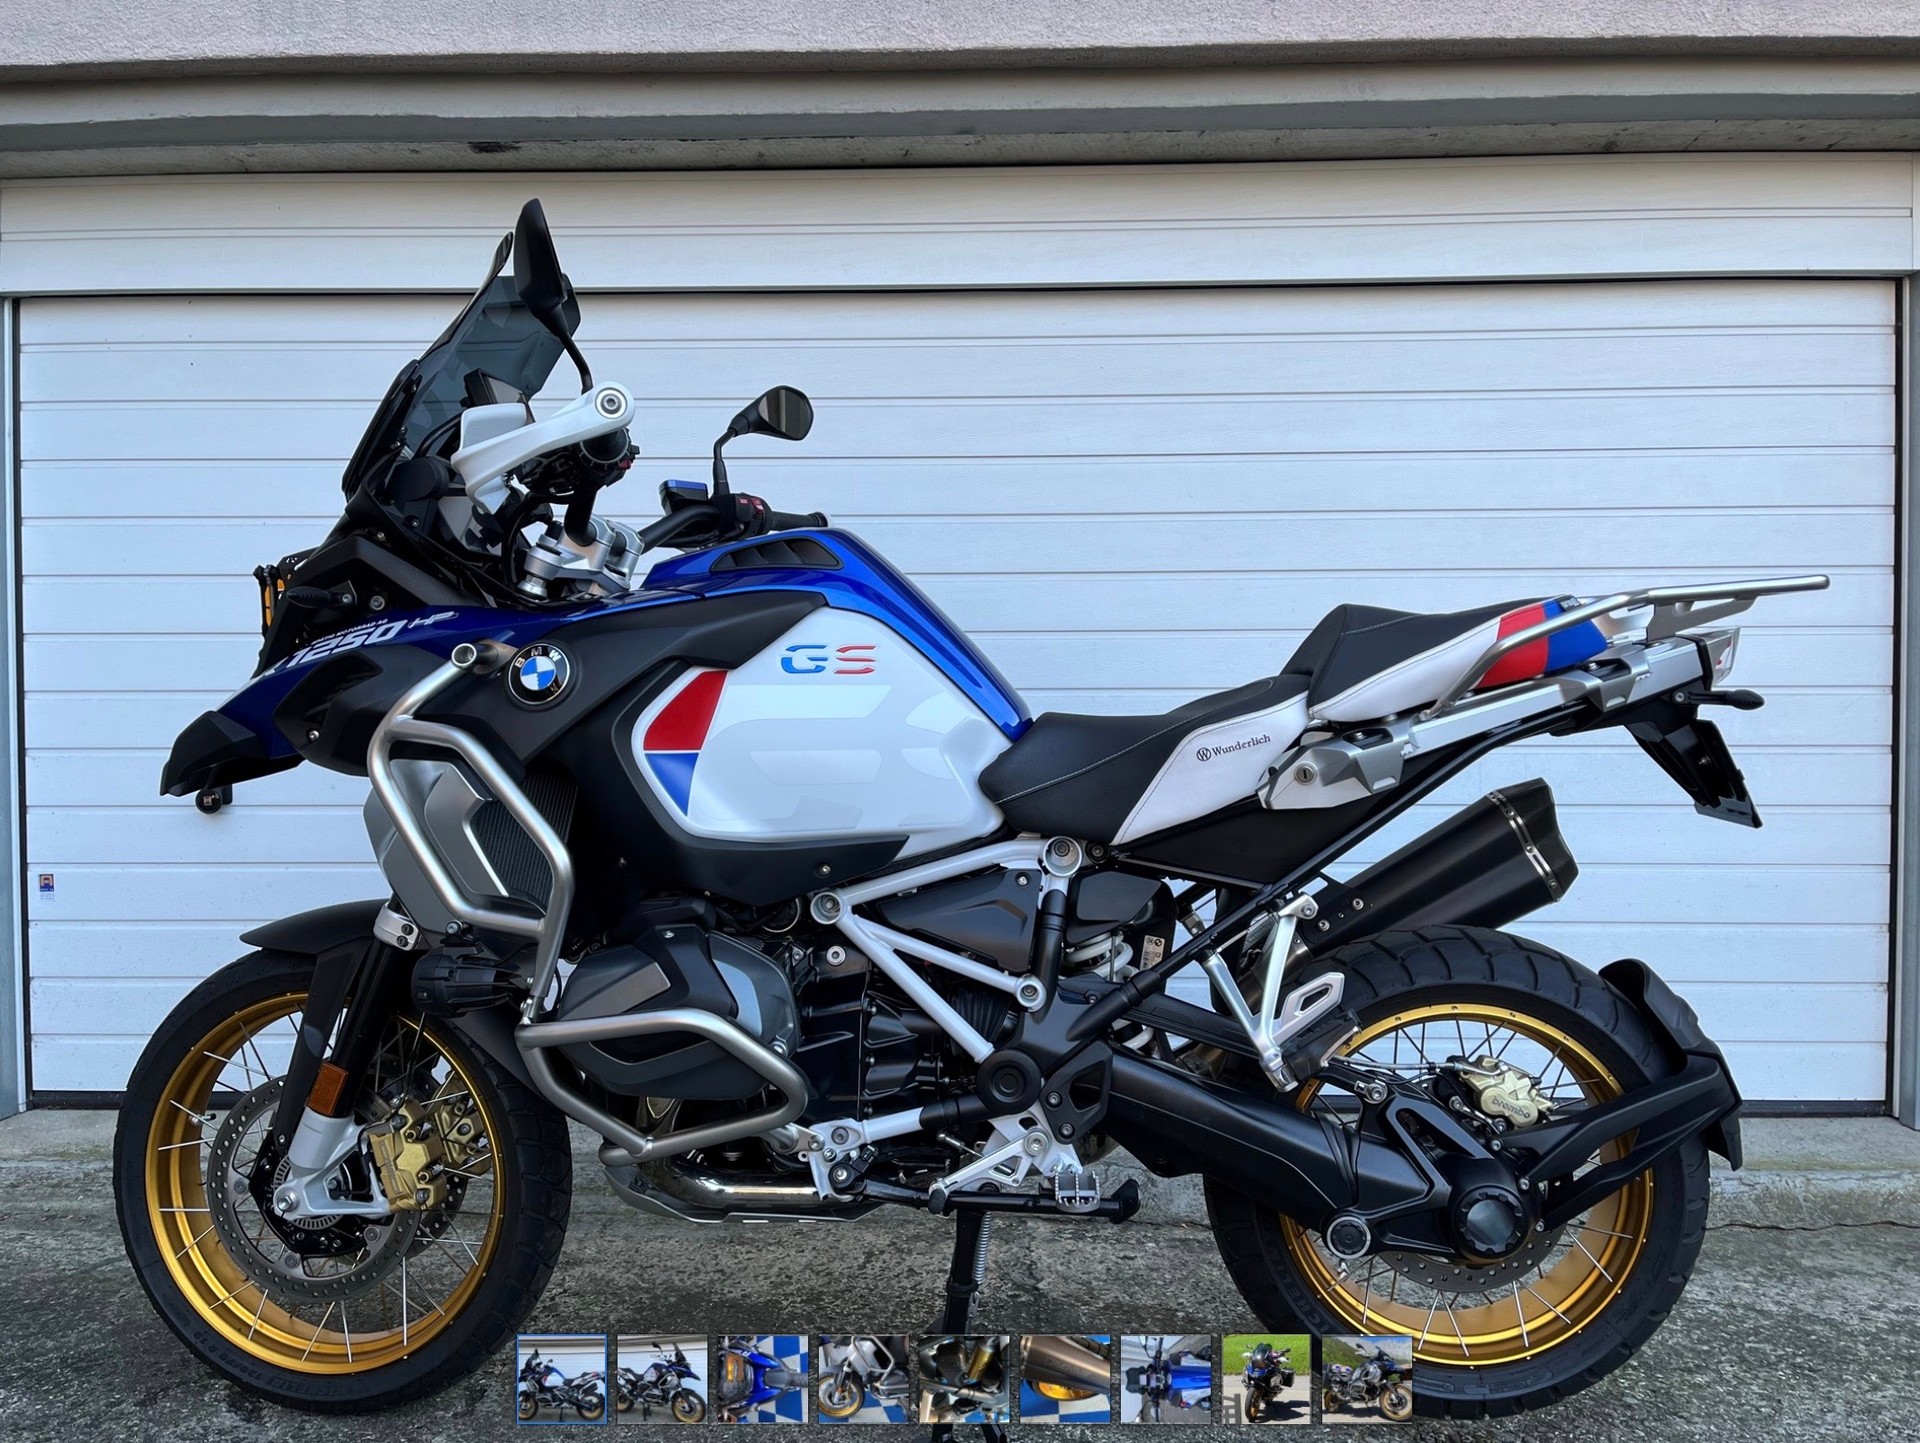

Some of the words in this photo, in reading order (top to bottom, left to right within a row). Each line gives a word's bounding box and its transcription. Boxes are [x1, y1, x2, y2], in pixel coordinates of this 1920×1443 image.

[286, 619, 408, 668] 1250
[514, 646, 562, 668] BMW
[781, 644, 877, 675] GS
[1211, 734, 1272, 756] Wunderlich
[1491, 1095, 1531, 1119] brembo
